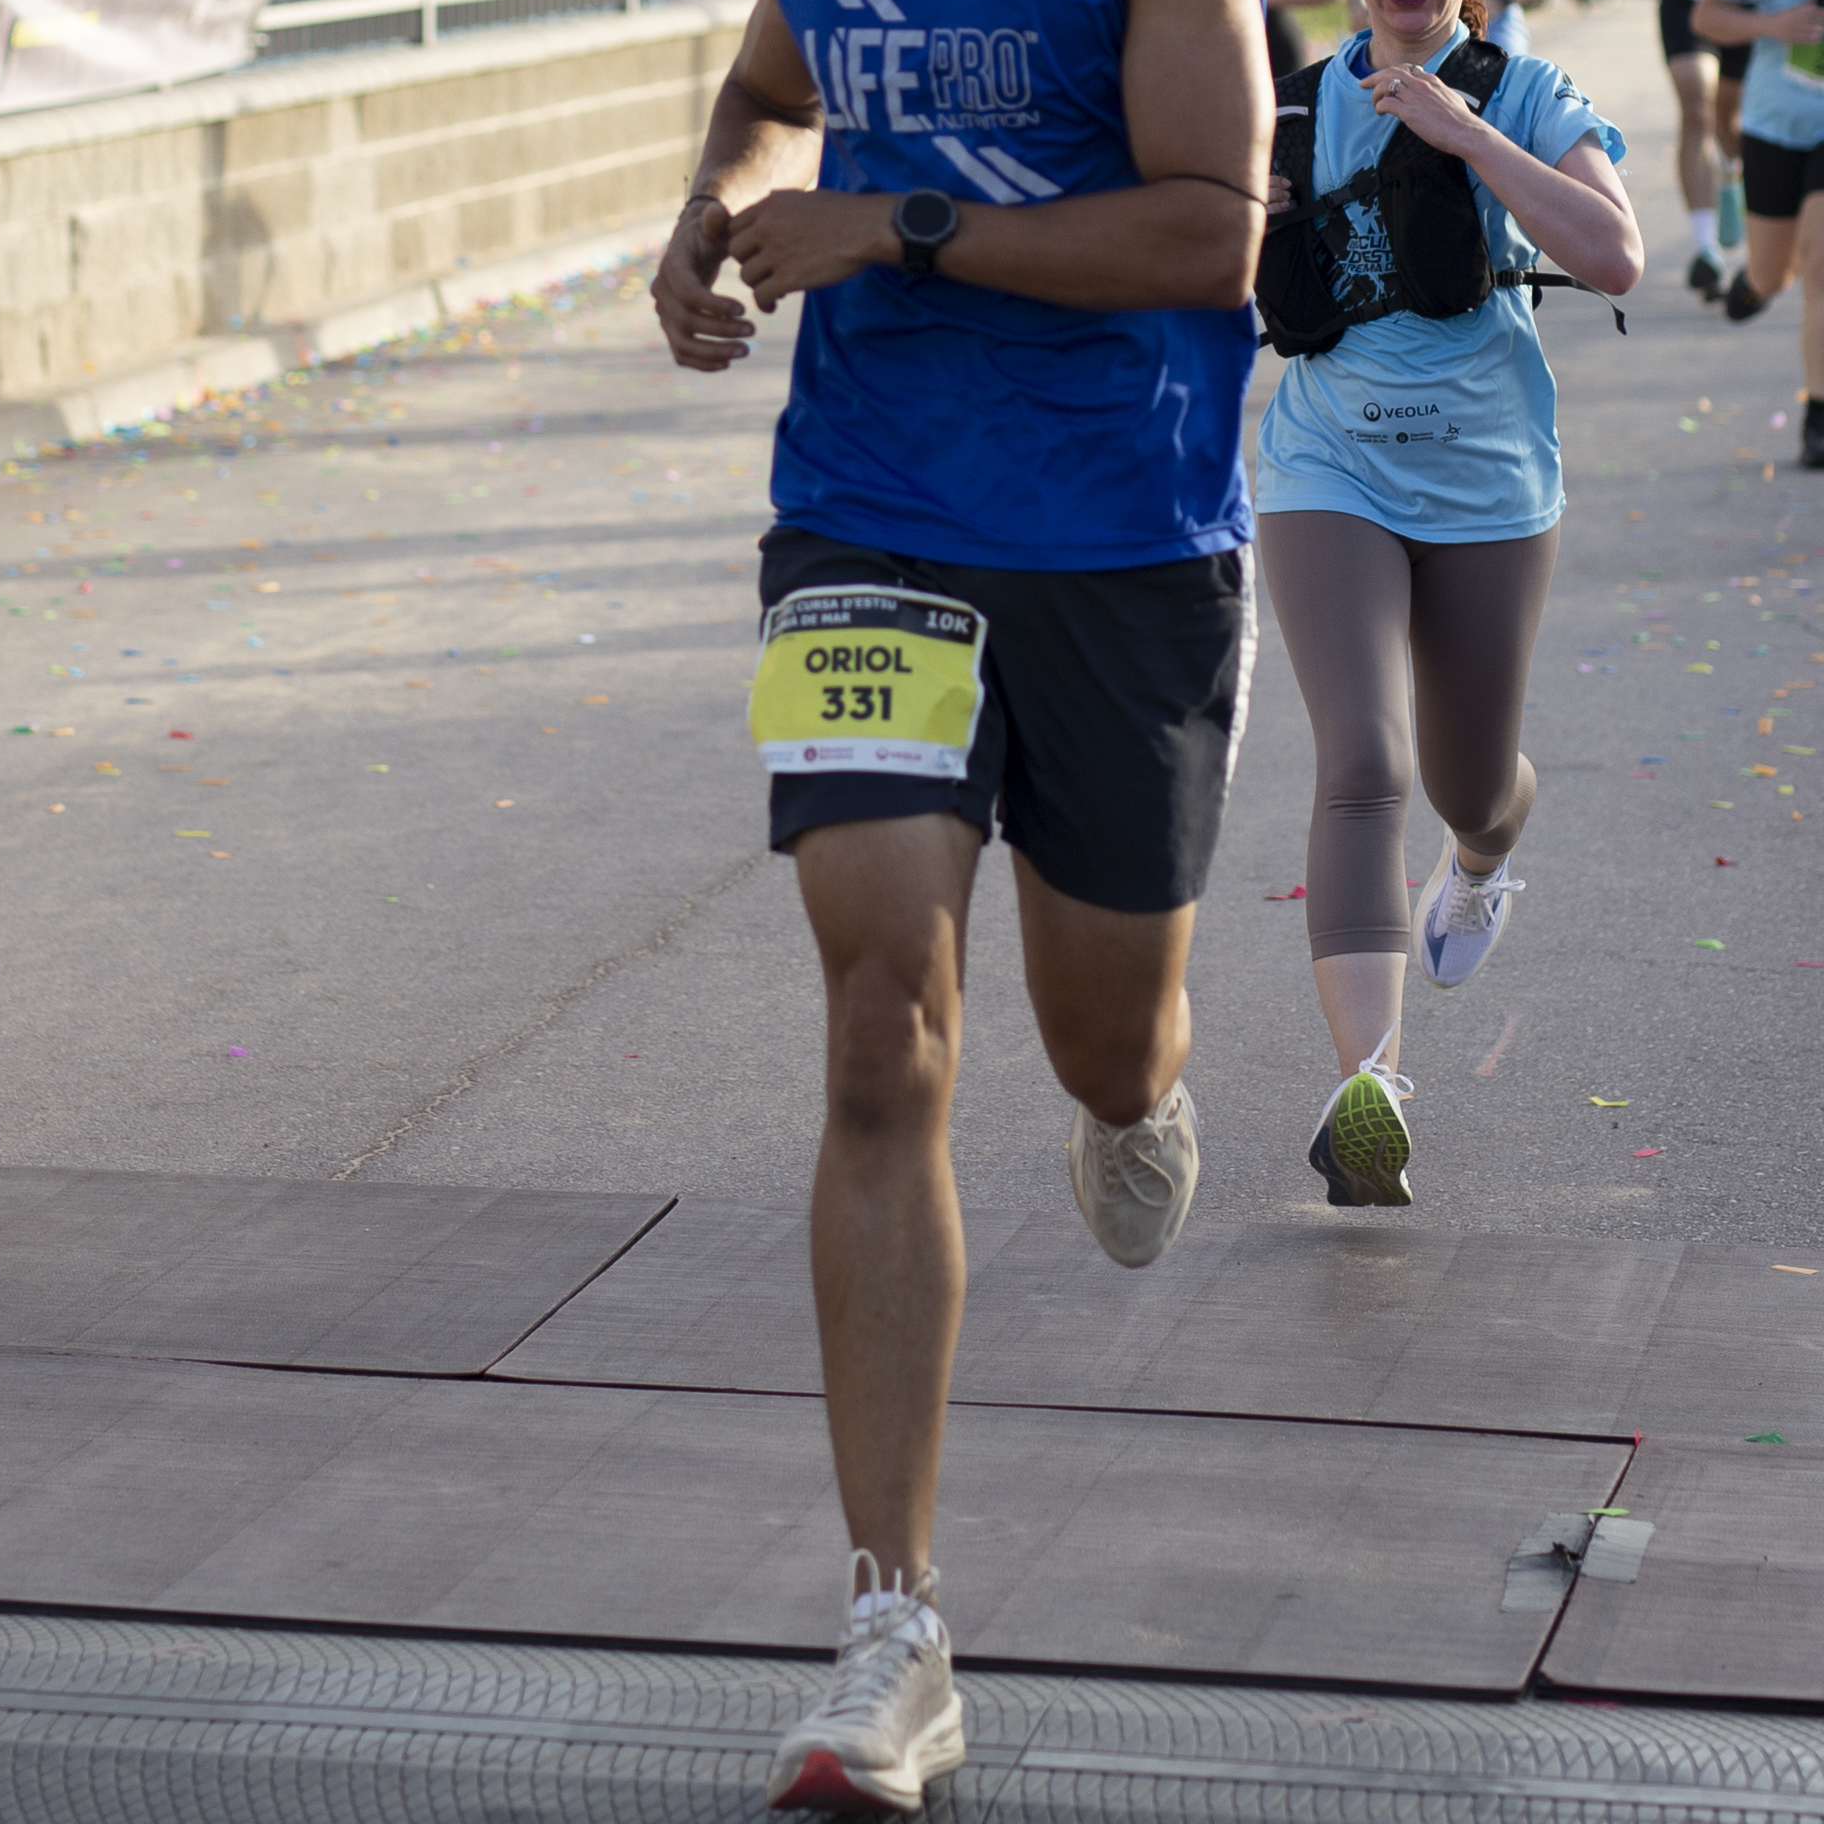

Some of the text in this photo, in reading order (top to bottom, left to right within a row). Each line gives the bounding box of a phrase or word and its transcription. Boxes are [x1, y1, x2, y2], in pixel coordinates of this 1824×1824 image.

[1383, 403, 1440, 419] VEOLIA
[926, 609, 972, 635] 10K
[805, 645, 913, 674] ORIOL
[820, 686, 893, 722] 331
